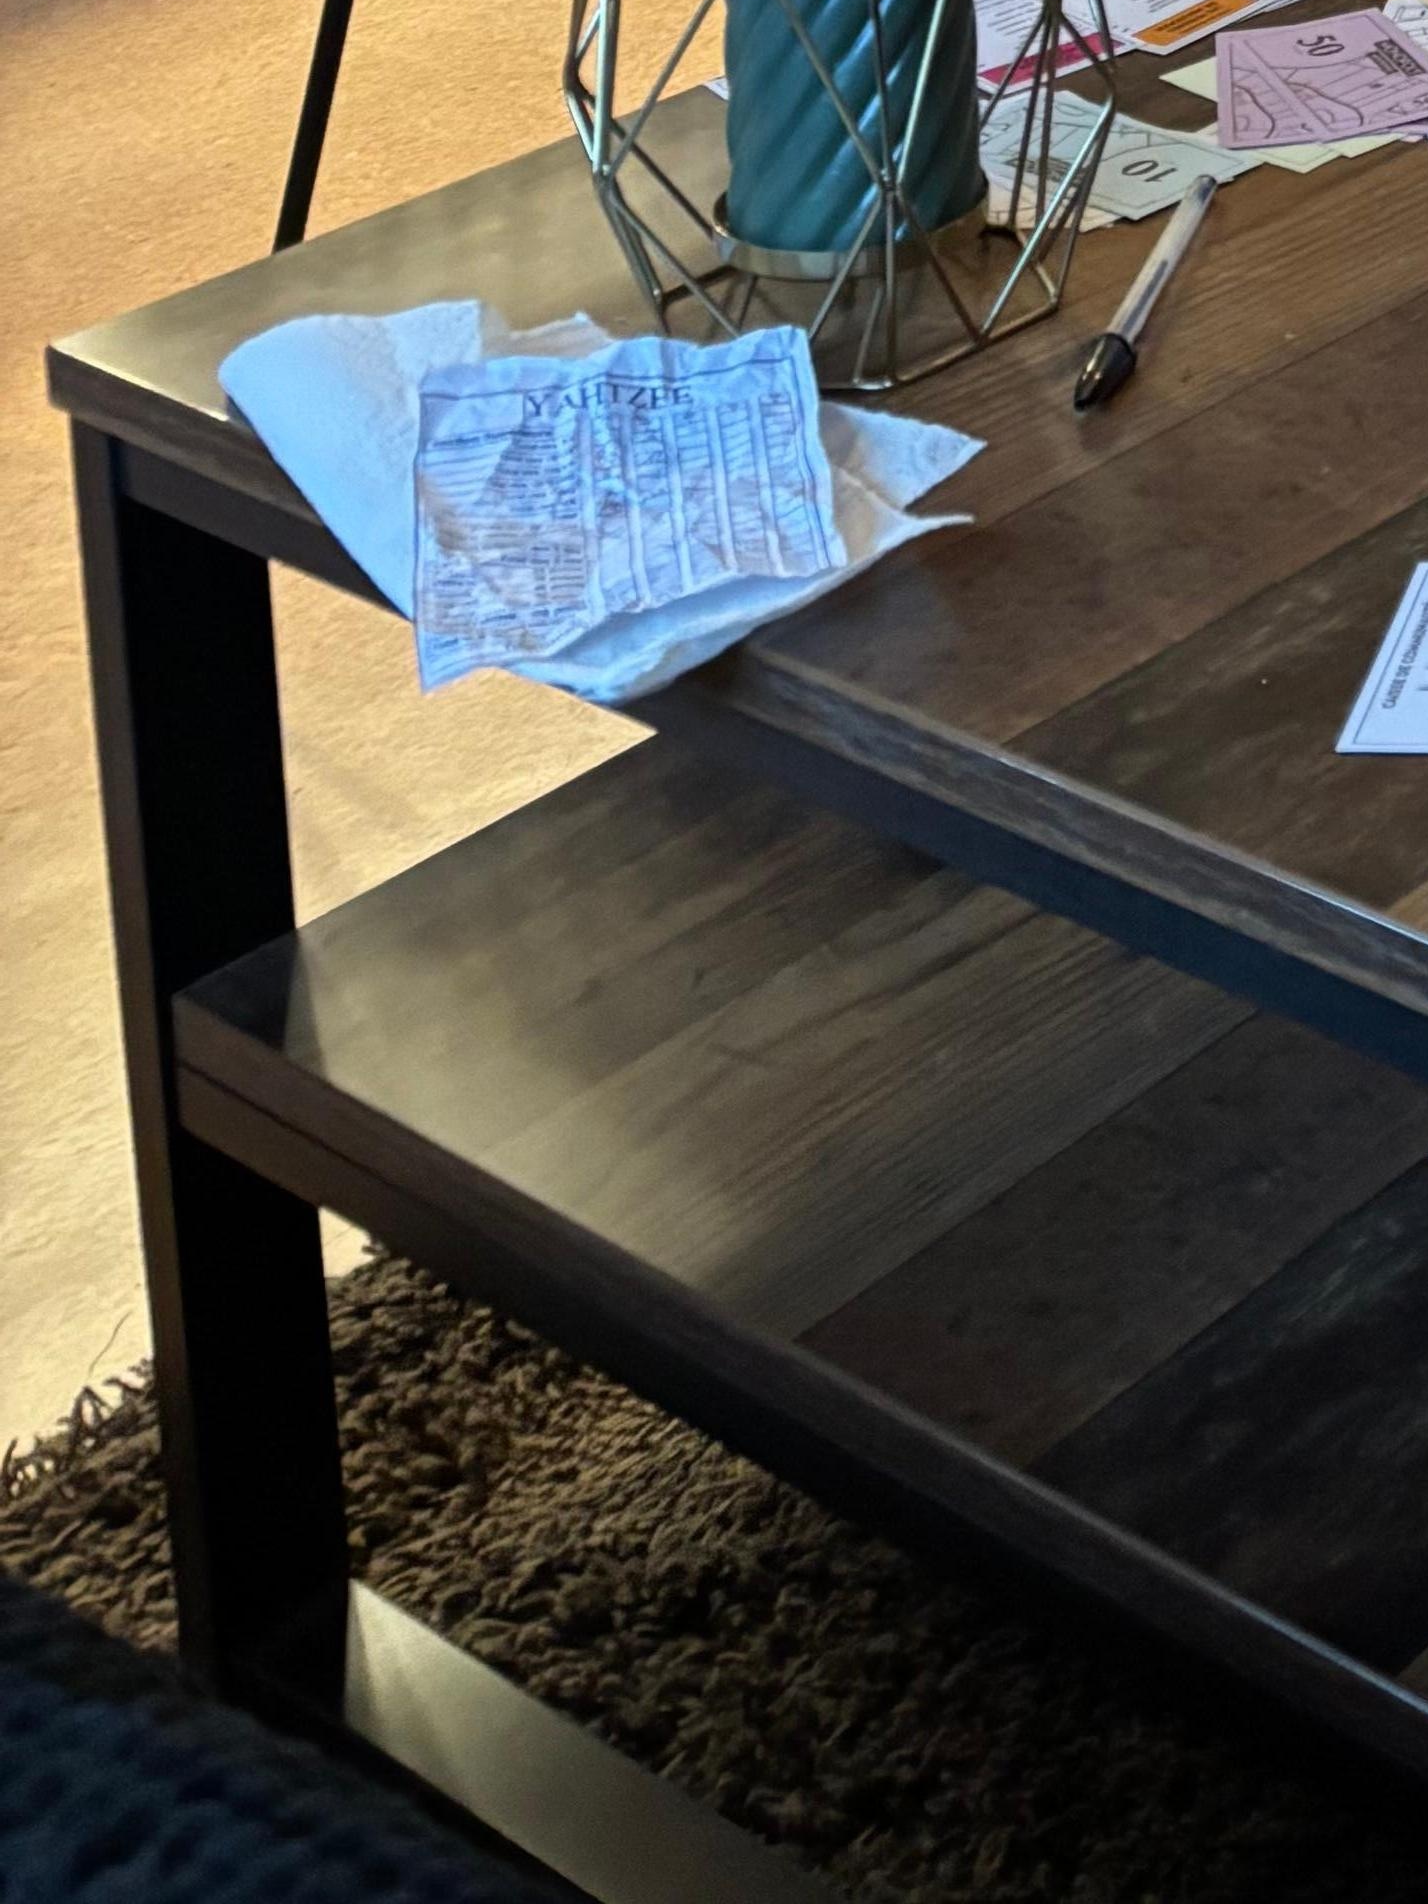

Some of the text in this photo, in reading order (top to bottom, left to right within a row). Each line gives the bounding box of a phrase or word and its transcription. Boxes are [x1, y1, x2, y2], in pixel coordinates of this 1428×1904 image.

[1297, 34, 1345, 57] 50
[1122, 159, 1181, 183] 10
[526, 381, 693, 418] YAHTZEE
